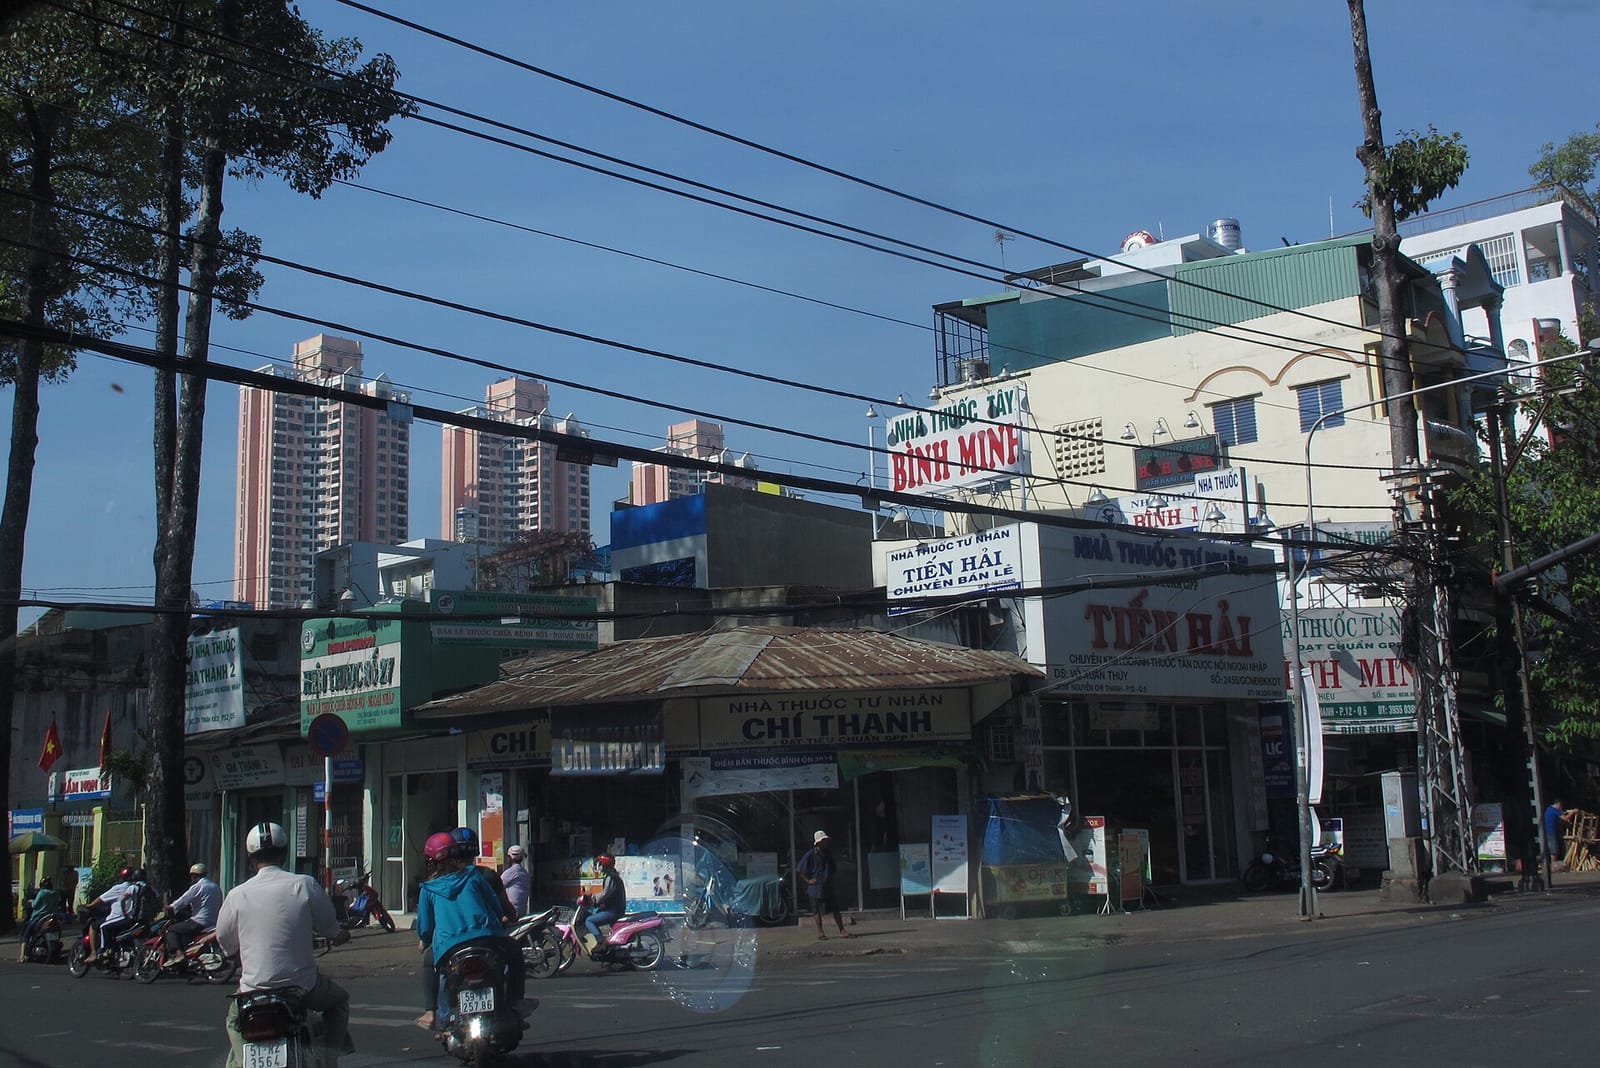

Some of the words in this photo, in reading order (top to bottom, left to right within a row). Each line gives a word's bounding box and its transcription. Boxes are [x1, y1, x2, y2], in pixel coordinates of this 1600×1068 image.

[895, 411, 927, 444] NHÀ
[929, 397, 977, 434] THUỐC
[986, 389, 1014, 421] TÂY
[892, 441, 949, 492] BÌNH
[1197, 475, 1213, 493] NHÀ
[1215, 472, 1239, 491] THUỐC
[891, 547, 914, 562] NHÀ
[916, 540, 954, 557] THUỐC
[956, 536, 972, 549] TƯ
[975, 529, 1010, 545] NHÂN
[1073, 532, 1112, 562] NHÀ
[1117, 539, 1177, 569] THUỐC
[1179, 547, 1202, 572] TƯ
[894, 579, 954, 597] CHUYÊN
[957, 571, 989, 585] BÁN
[994, 563, 1014, 577] LẺ
[903, 555, 954, 583] TIẾN
[961, 547, 1003, 572] HẢI
[1084, 589, 1177, 654] TIẾN
[1185, 600, 1254, 658] HẢI
[1299, 610, 1358, 638] THUỐC
[1361, 612, 1386, 638] TƯ
[212, 632, 236, 655] THUỐC
[1326, 640, 1374, 652] CHUẨN
[230, 663, 236, 678] 2
[1357, 658, 1418, 688] MIN
[729, 699, 772, 714] NHÀ
[778, 693, 848, 711] THUỐC
[855, 696, 881, 709] TƯ
[889, 690, 944, 707] NHÂN
[490, 724, 538, 755] CHÍ
[743, 712, 784, 741] CHÍ
[793, 710, 933, 737] THANH
[753, 755, 779, 767] THUỐC
